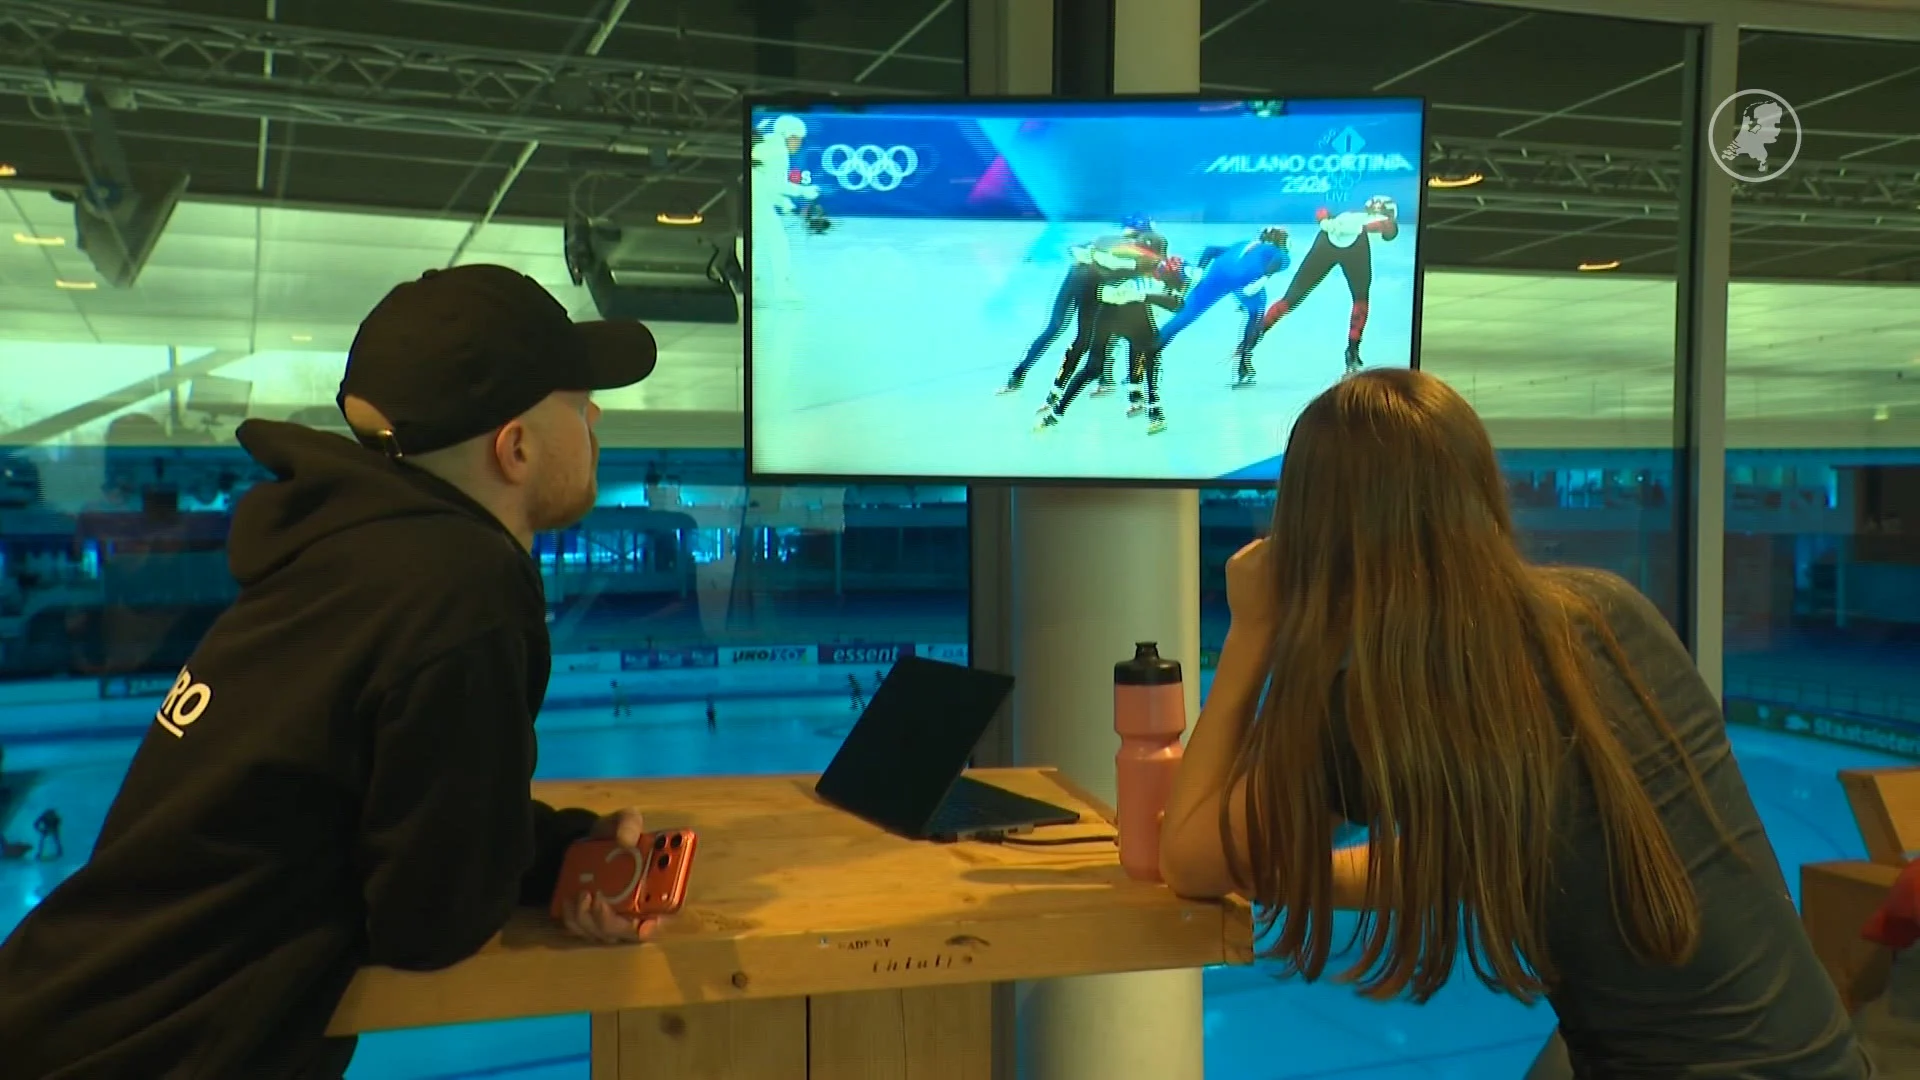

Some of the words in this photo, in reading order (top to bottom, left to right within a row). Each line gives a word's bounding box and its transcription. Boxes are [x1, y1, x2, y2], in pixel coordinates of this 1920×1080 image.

[1206, 154, 1305, 173] MILANO
[1307, 153, 1413, 173] CORTINA
[1281, 176, 1331, 193] 2026
[1326, 191, 1347, 202] LIVE
[833, 647, 898, 662] essent
